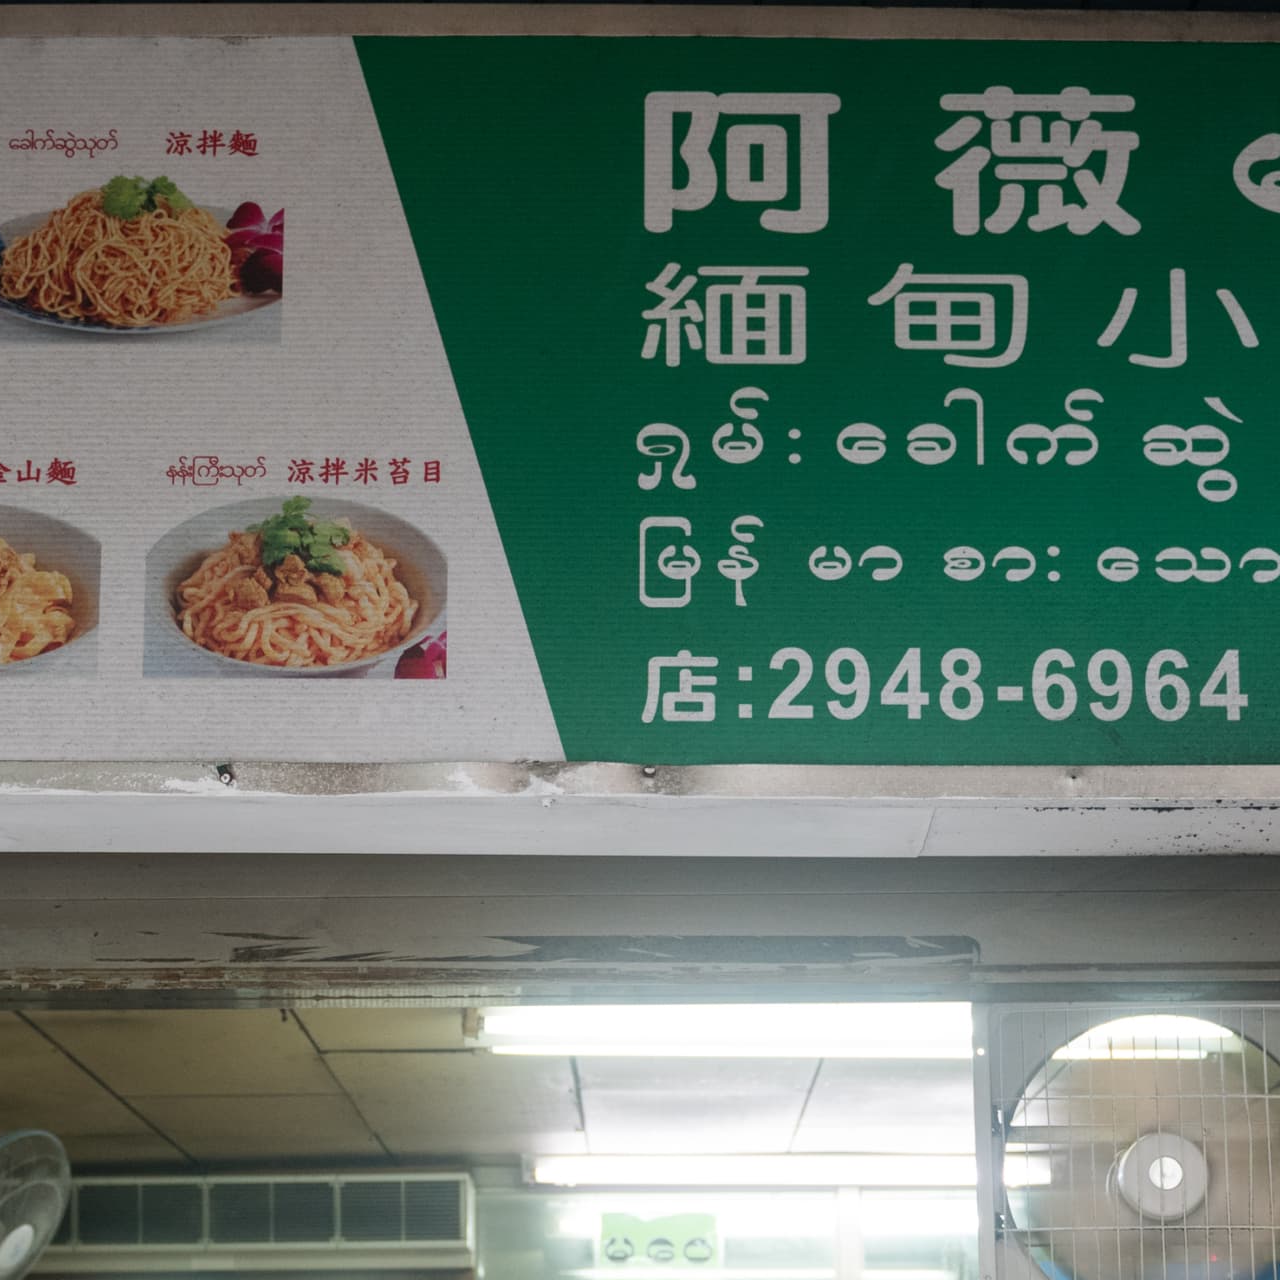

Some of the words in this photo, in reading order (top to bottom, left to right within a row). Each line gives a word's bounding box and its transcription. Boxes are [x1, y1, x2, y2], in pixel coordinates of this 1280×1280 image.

[165, 128, 260, 159] 涼拌麵
[644, 86, 1143, 237] 阿薇
[287, 457, 444, 487] 涼拌米苔目
